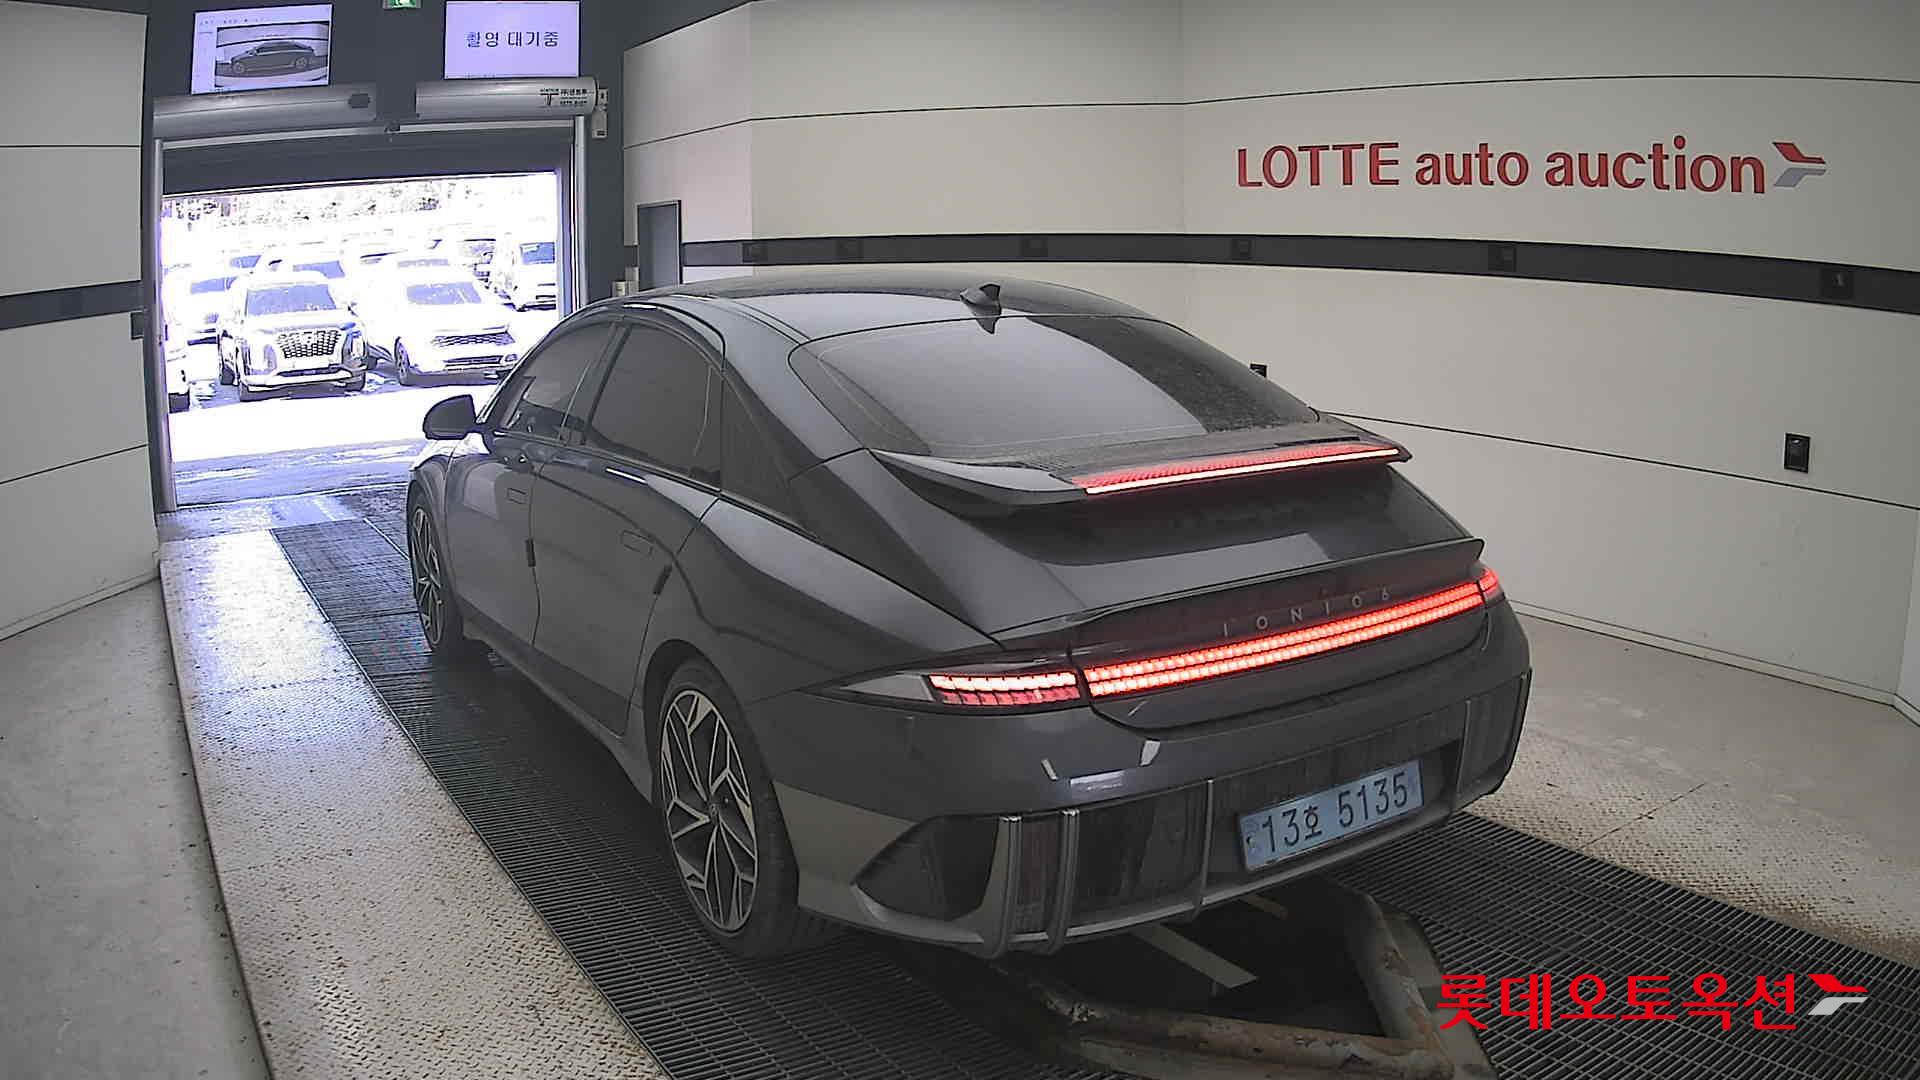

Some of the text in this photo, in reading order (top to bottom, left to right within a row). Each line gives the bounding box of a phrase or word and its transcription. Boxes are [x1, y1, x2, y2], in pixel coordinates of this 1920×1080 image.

[508, 31, 559, 48] 대기중
[1237, 135, 1767, 194] LOTTE auto auction
[1262, 771, 1409, 852] 13호 5135
